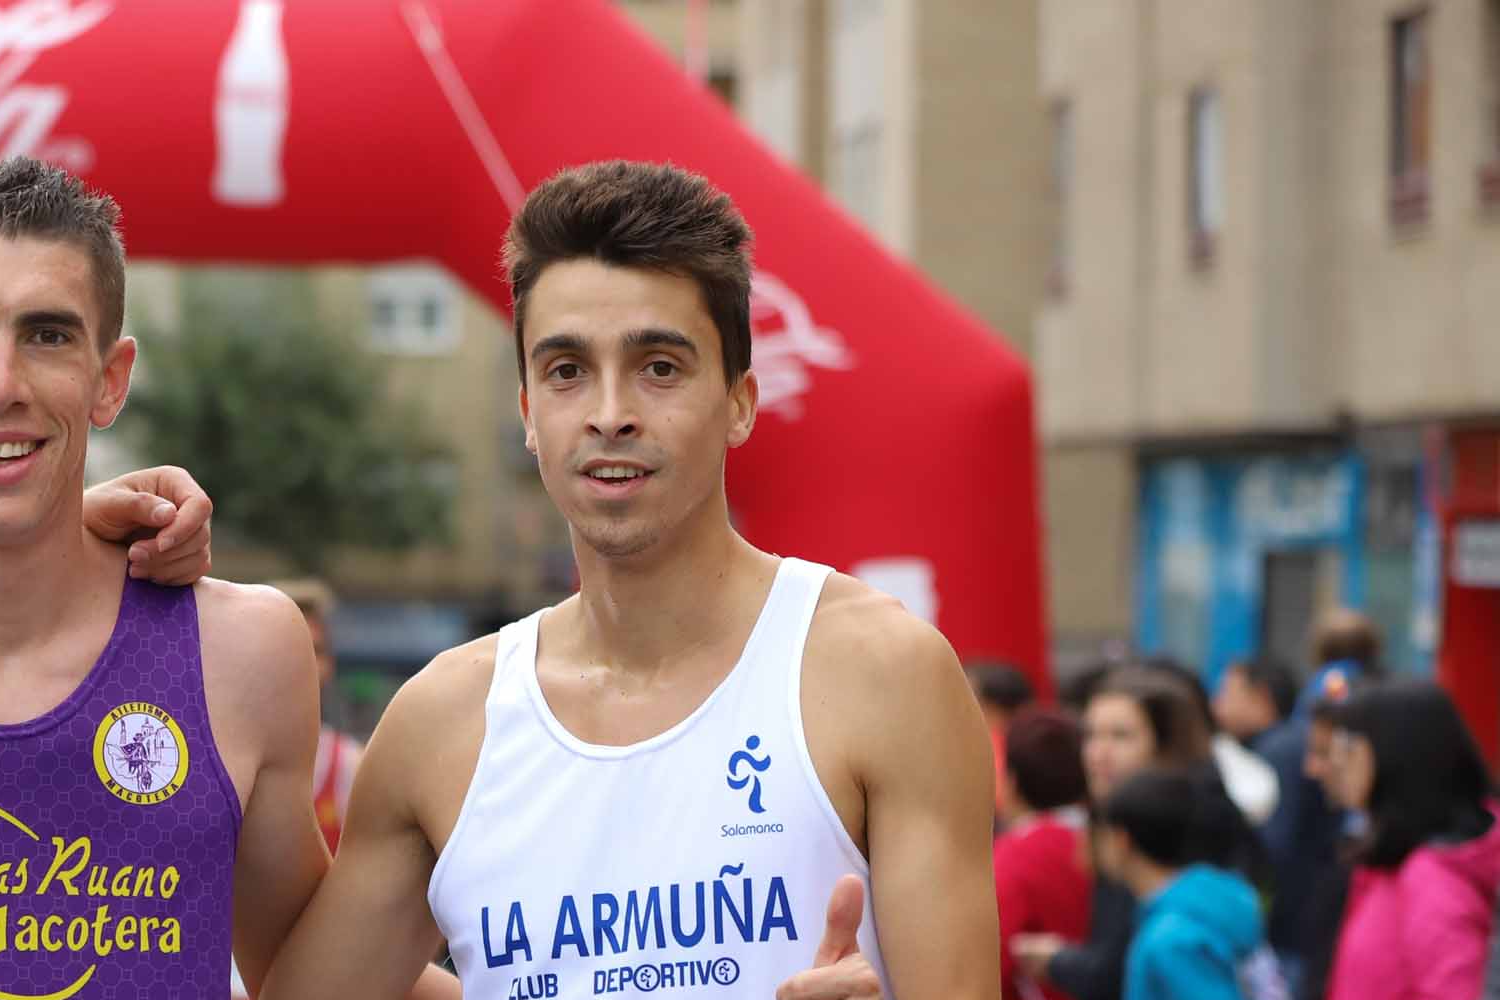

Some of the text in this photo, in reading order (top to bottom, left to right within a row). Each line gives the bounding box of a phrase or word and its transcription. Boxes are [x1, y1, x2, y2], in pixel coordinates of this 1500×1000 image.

[105, 779, 179, 803] MACOTERA
[721, 823, 784, 837] Salamanca
[35, 836, 181, 899] Ruano
[481, 862, 798, 968] LA ARMUÑA
